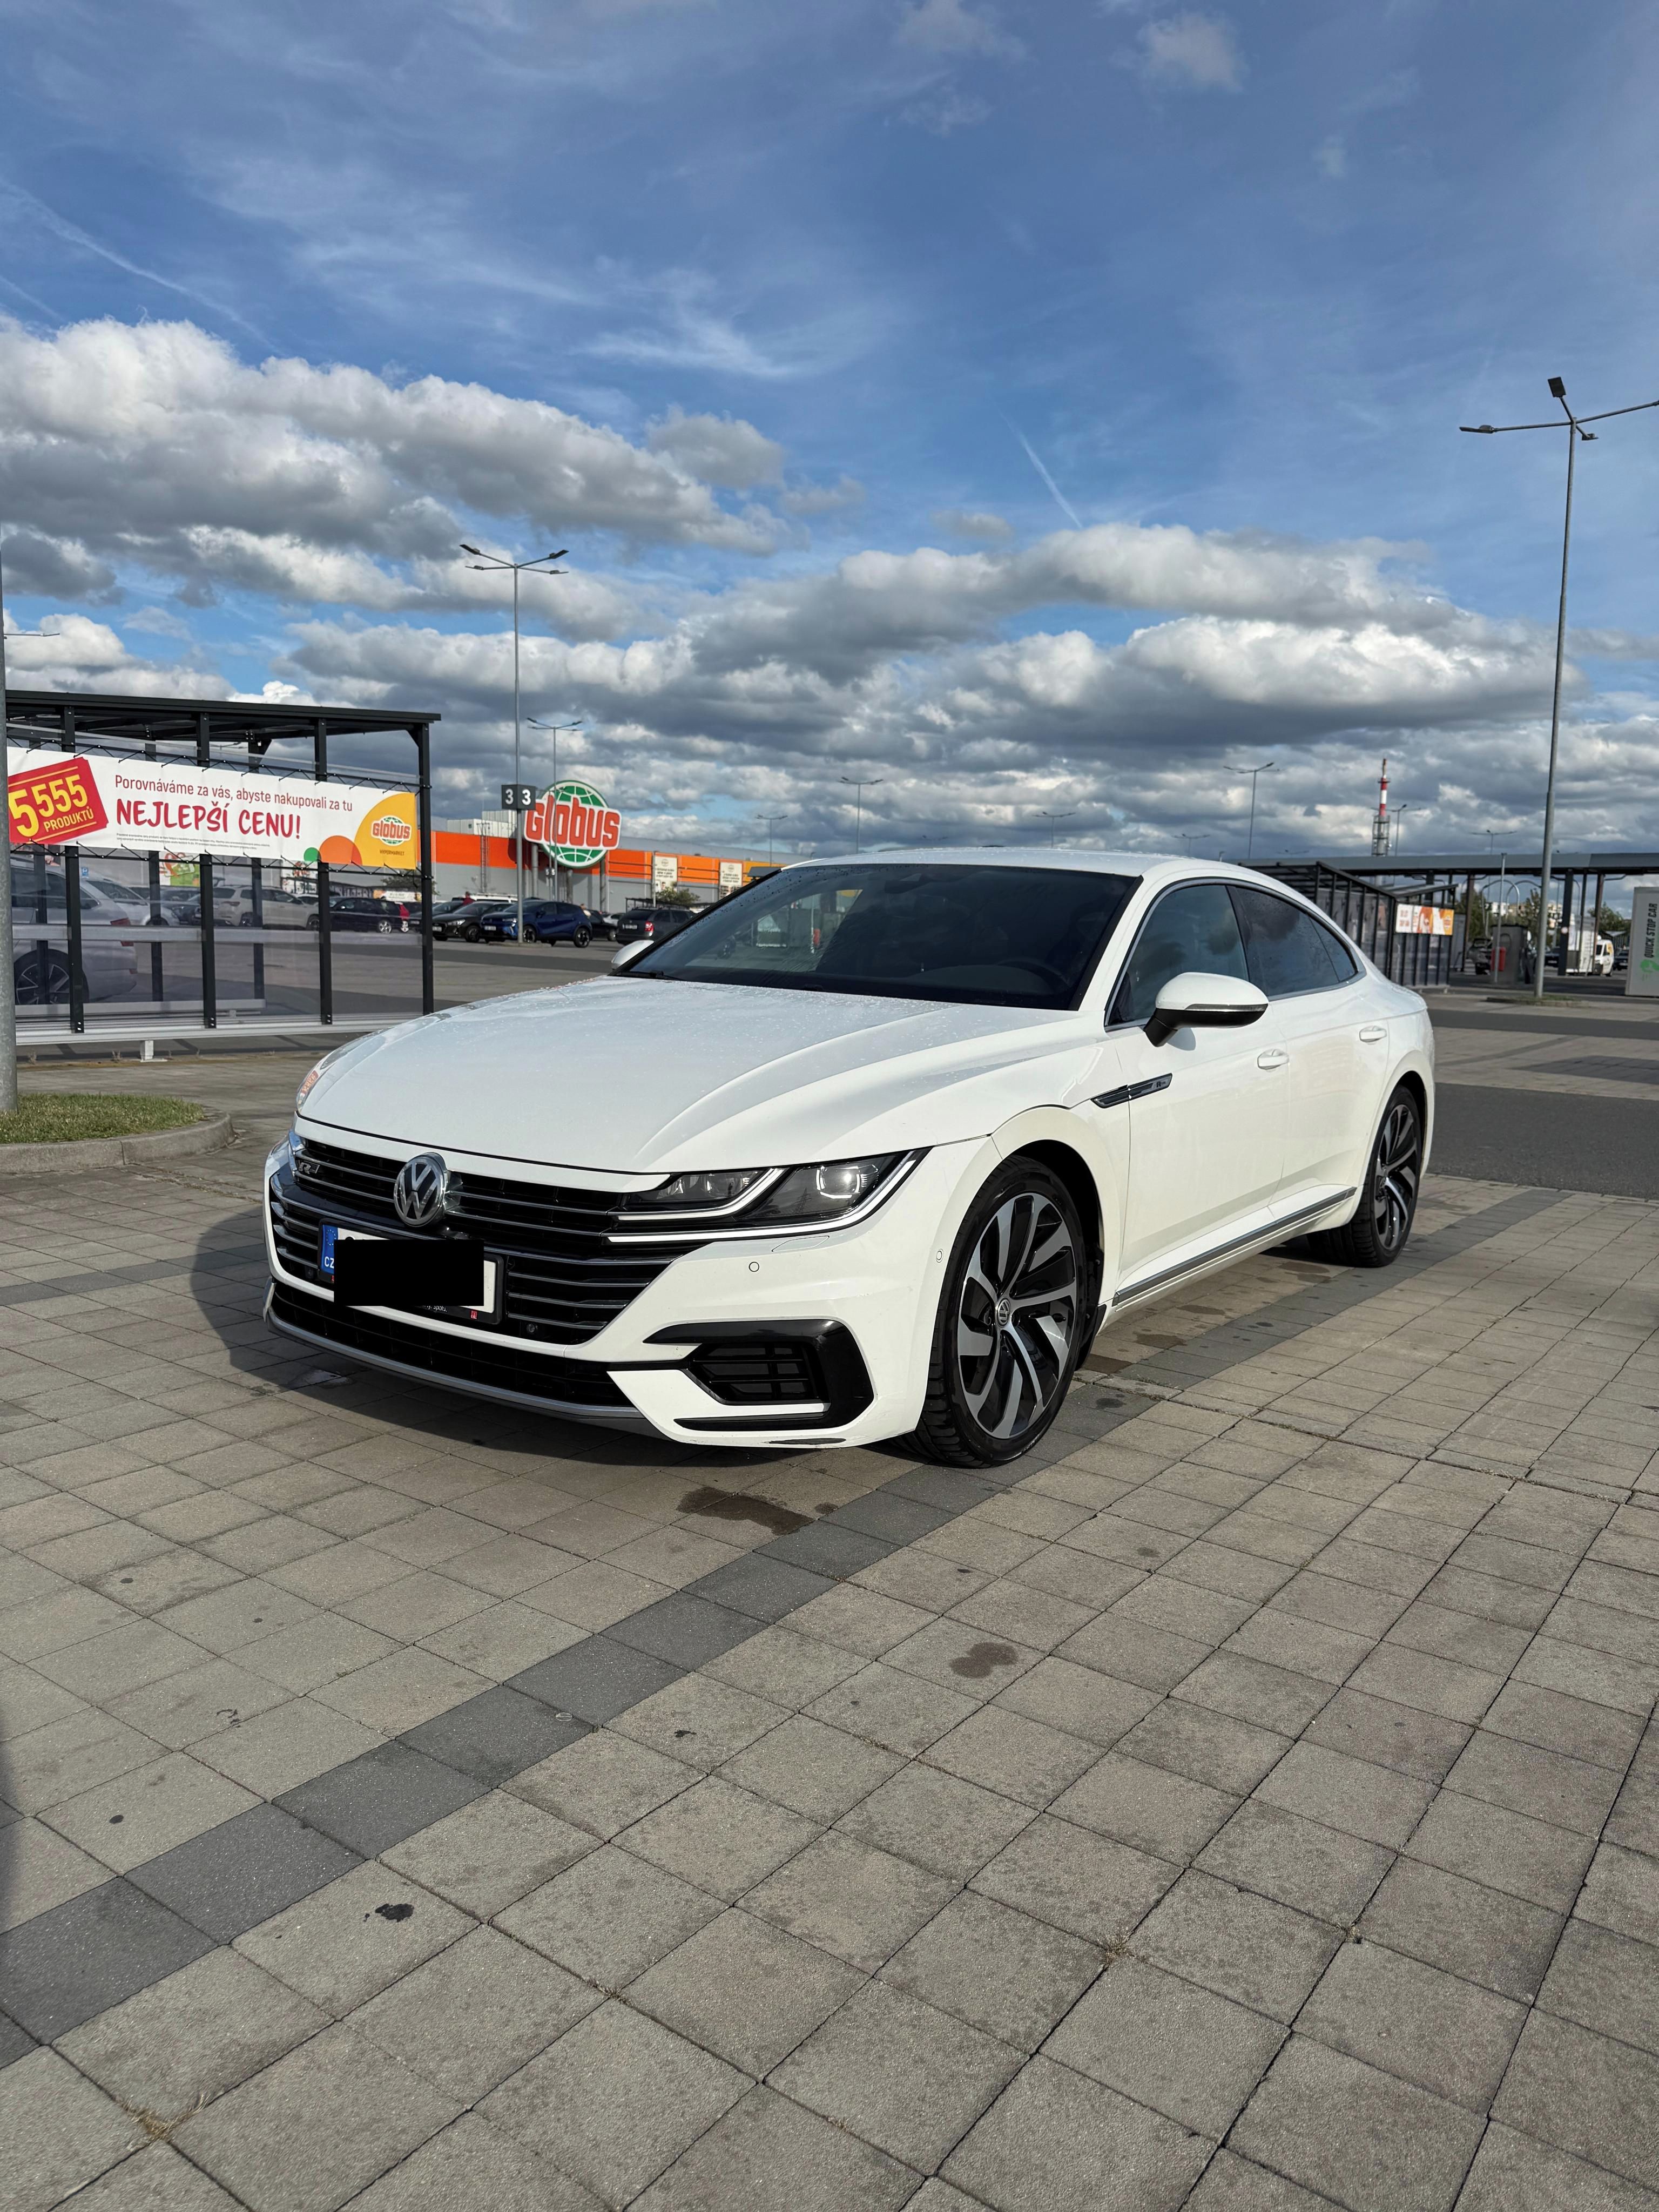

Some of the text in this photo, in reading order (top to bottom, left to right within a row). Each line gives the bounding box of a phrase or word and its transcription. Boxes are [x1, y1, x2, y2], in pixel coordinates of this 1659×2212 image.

[115, 774, 353, 811] Porovnáváme za vás, abyste nakupovali za tu
[505, 788, 514, 805] 3
[522, 789, 531, 805] 3
[43, 806, 95, 832] PRODUKTŮ
[117, 798, 300, 839] NEJLEPŠÍ CENU!
[1644, 902, 1658, 959] QUICK STOP CAR
[325, 1256, 334, 1269] CZ
